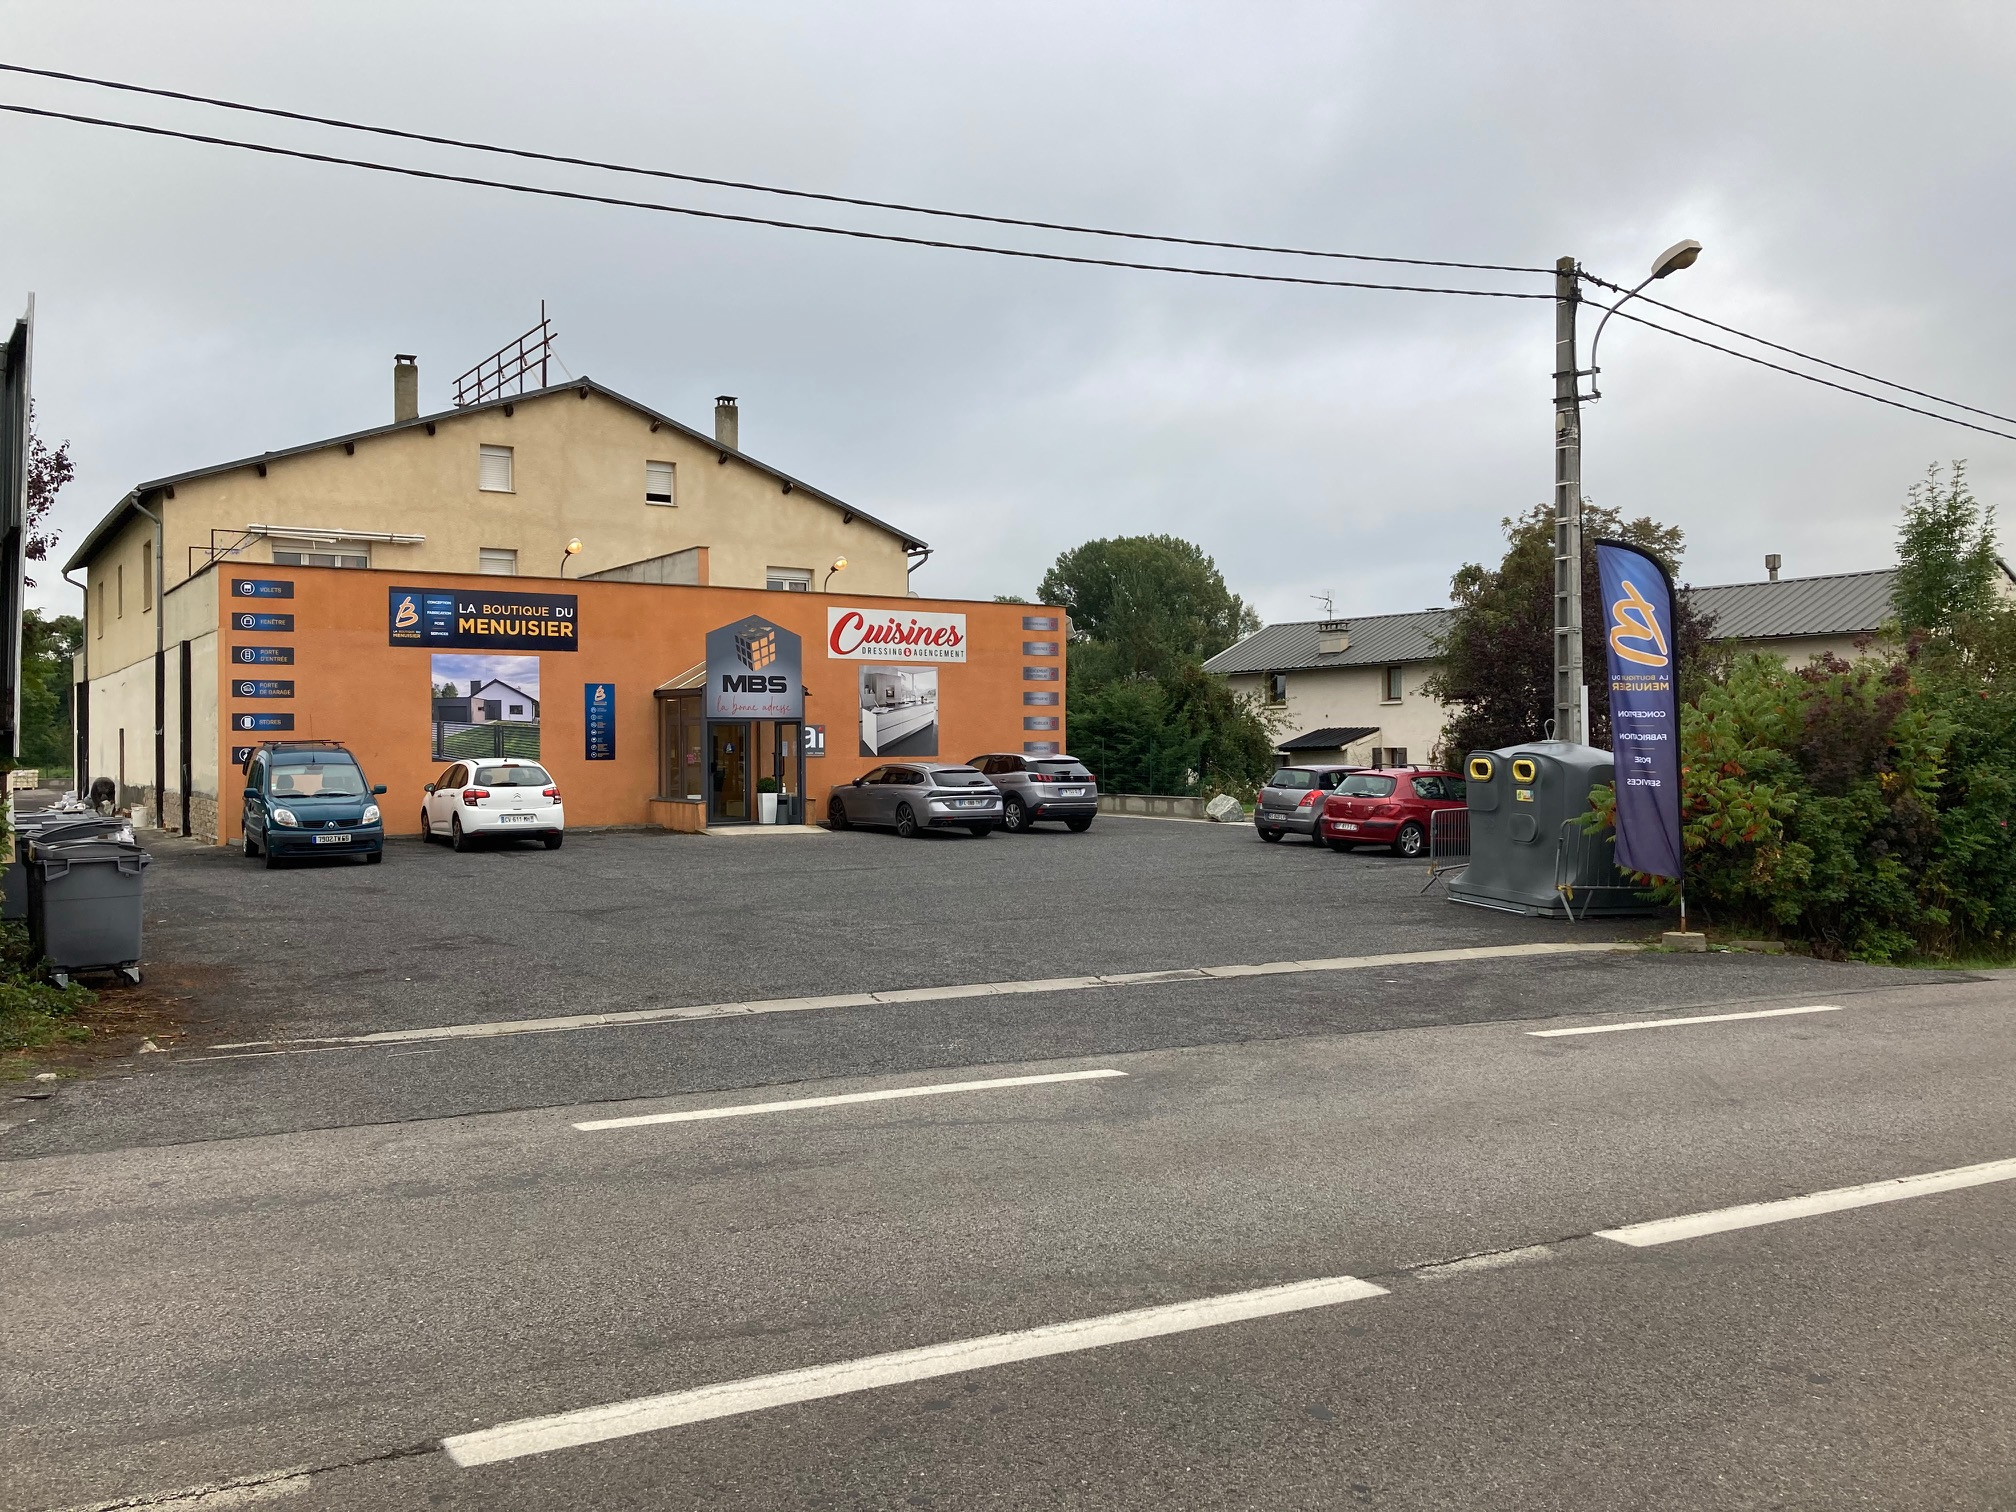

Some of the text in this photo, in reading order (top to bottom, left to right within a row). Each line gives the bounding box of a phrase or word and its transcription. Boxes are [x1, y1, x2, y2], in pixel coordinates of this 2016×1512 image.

[458, 603, 574, 618] LA BOUTIQUE DU
[458, 617, 574, 638] MENUISIER
[829, 611, 964, 656] Cuisines
[861, 646, 903, 656] DRESSING
[913, 648, 965, 658] AGENCEMENT
[722, 675, 788, 694] MBS
[716, 695, 792, 716] la bonne adresse
